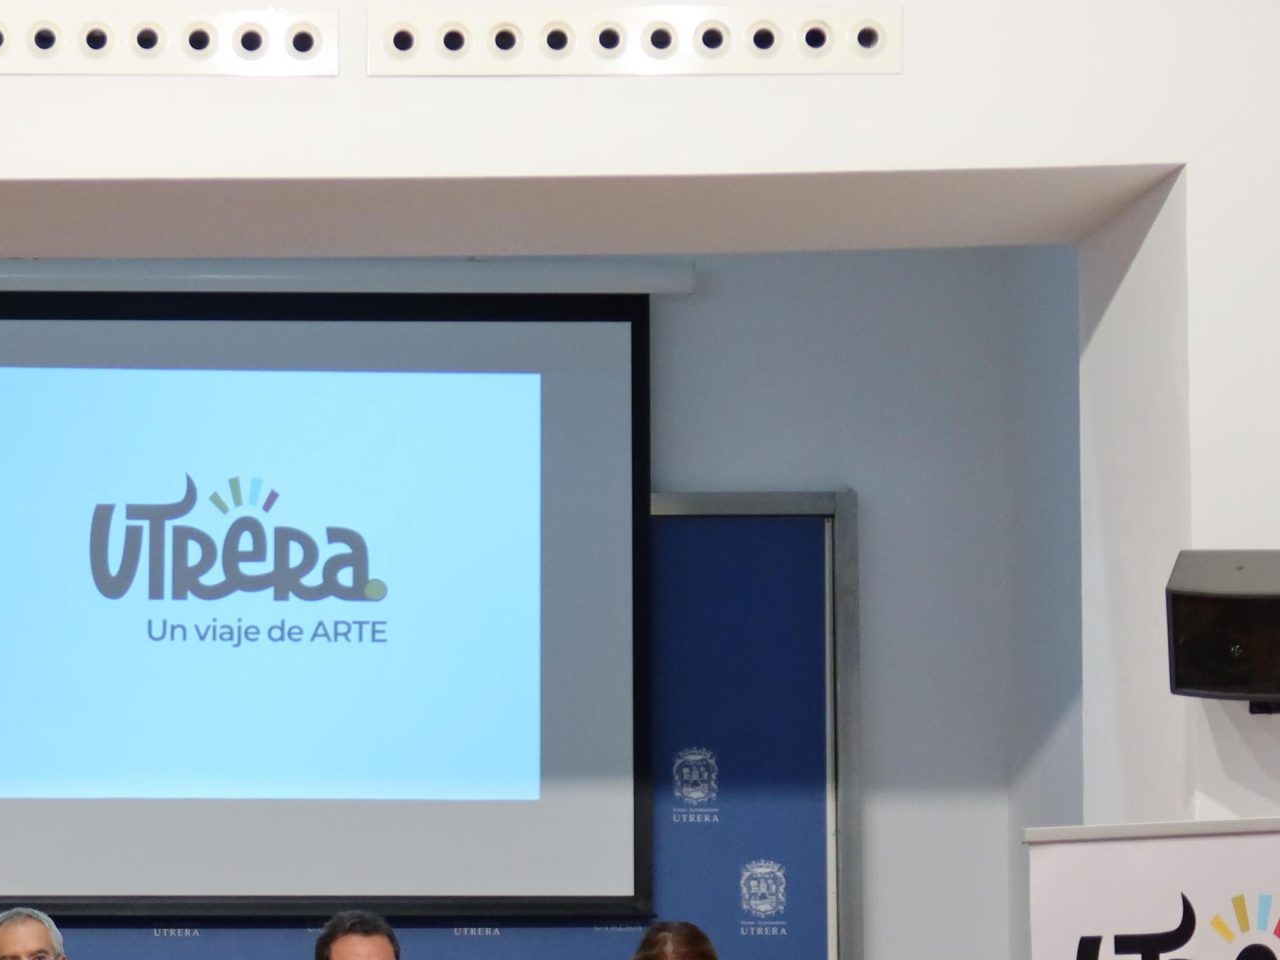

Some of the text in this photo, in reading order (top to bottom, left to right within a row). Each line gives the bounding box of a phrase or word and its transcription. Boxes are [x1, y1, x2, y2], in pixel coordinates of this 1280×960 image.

[147, 618, 388, 648] Un viaje de ARTE
[673, 814, 719, 823] UTRERA
[153, 928, 200, 937] UTRERA
[453, 927, 501, 936] UTRERA
[740, 927, 788, 936] UTRERA
